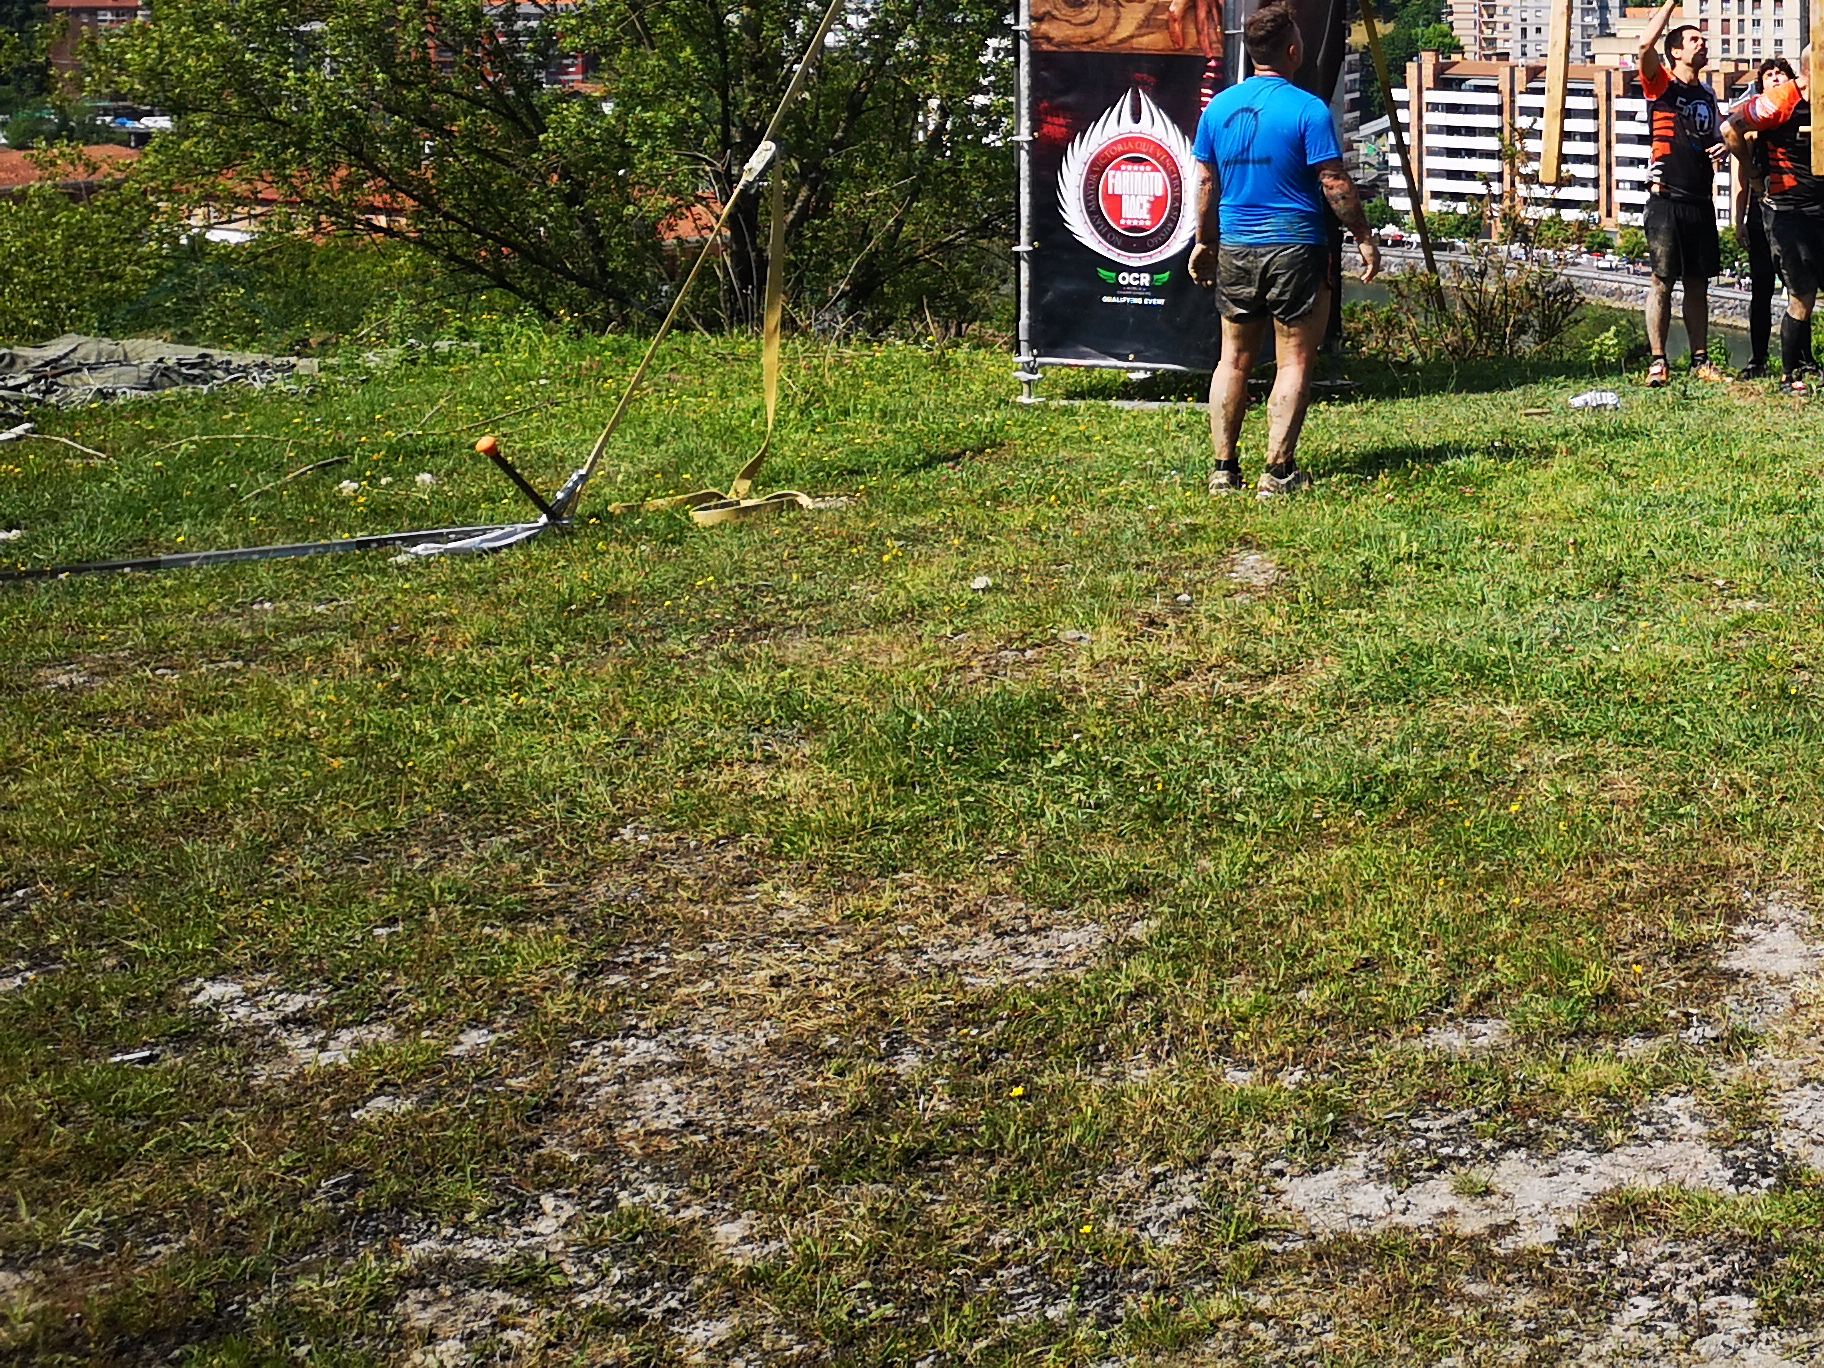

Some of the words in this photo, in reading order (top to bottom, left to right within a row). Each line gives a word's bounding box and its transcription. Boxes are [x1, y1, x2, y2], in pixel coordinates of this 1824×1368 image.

[1086, 174, 1097, 211] MAYOR
[1092, 140, 1134, 171] VICTORIA
[1121, 194, 1151, 219] RACE
[1118, 272, 1150, 286] OCR
